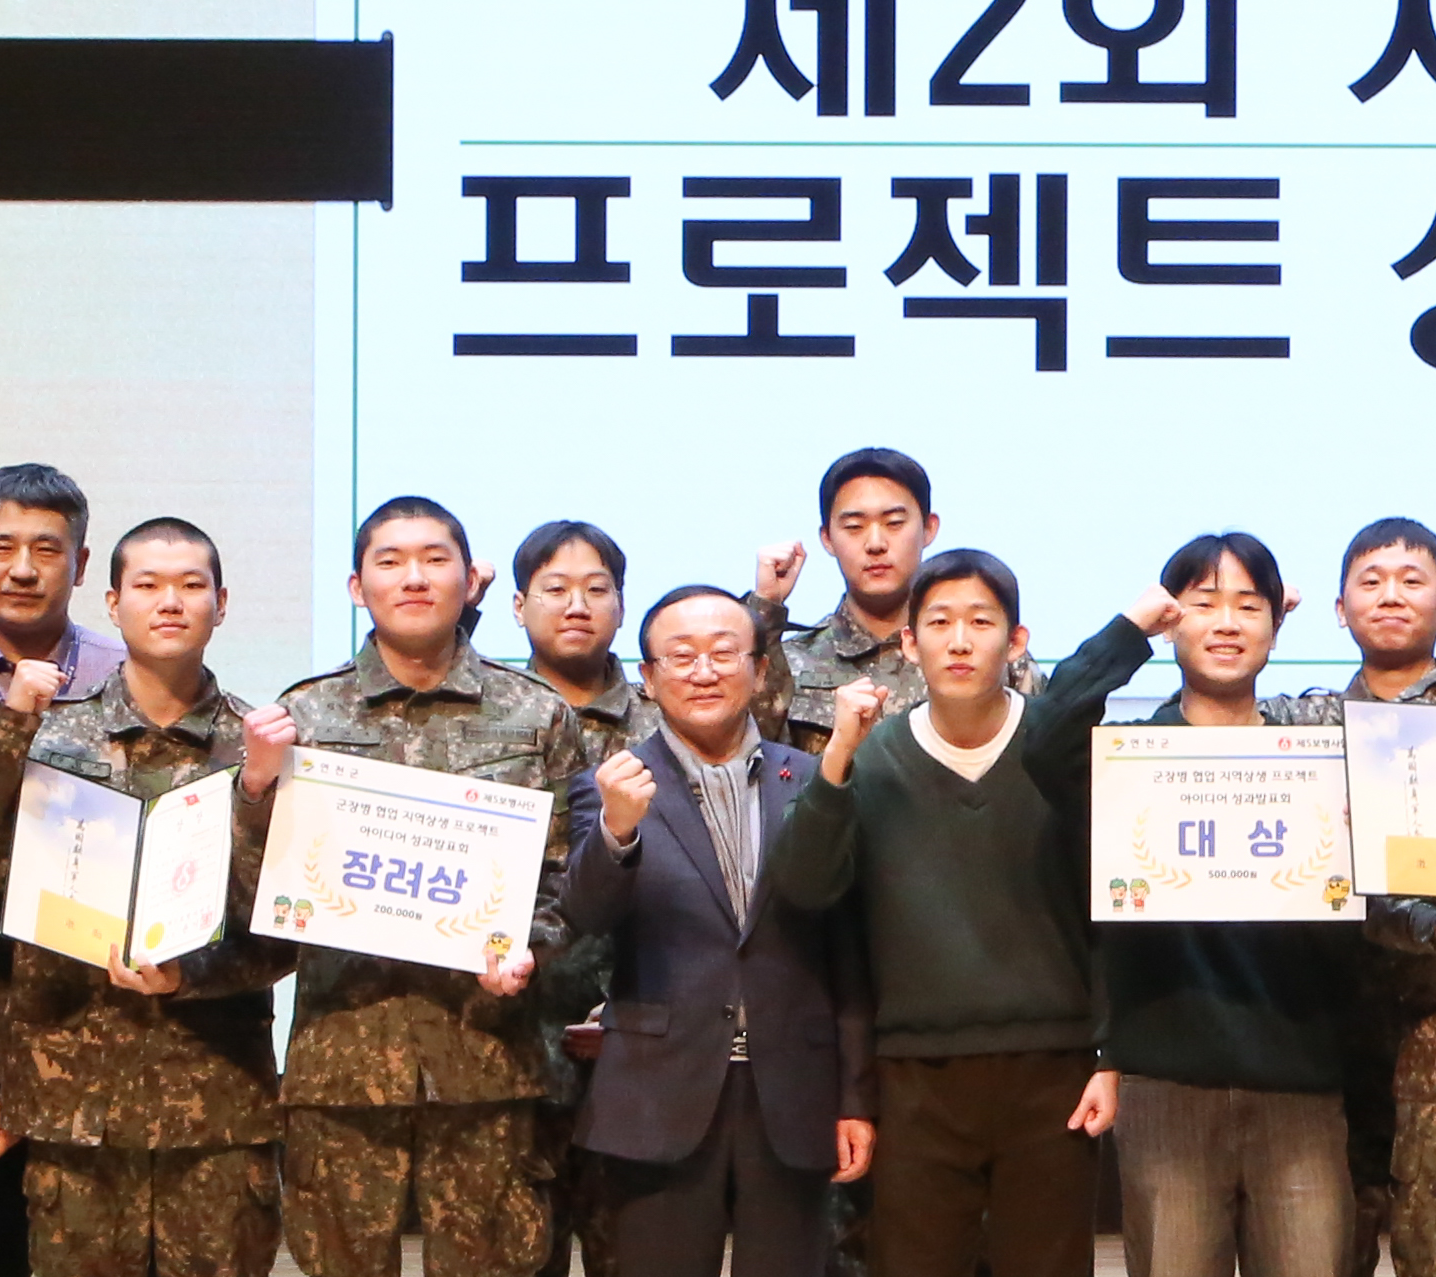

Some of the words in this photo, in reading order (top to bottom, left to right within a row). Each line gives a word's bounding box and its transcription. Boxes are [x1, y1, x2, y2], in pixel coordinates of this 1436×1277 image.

[449, 170, 1296, 380] 프로젝트
[1153, 770, 1188, 784] 군장병
[1192, 770, 1215, 784] 협업
[1219, 770, 1268, 783] 지역상생
[1271, 769, 1319, 782] 프로젝트
[483, 793, 536, 812] 제5보병사단
[1180, 792, 1228, 805] 아이디어
[1231, 792, 1292, 805] 성과발표회
[335, 797, 371, 816] 군장병
[375, 804, 399, 821] 협업
[402, 810, 451, 829] 지역상생
[454, 819, 500, 838] 프로젝트
[359, 824, 407, 844] 아이디어
[411, 833, 470, 855] 성과발표회
[341, 849, 468, 906] 장려상
